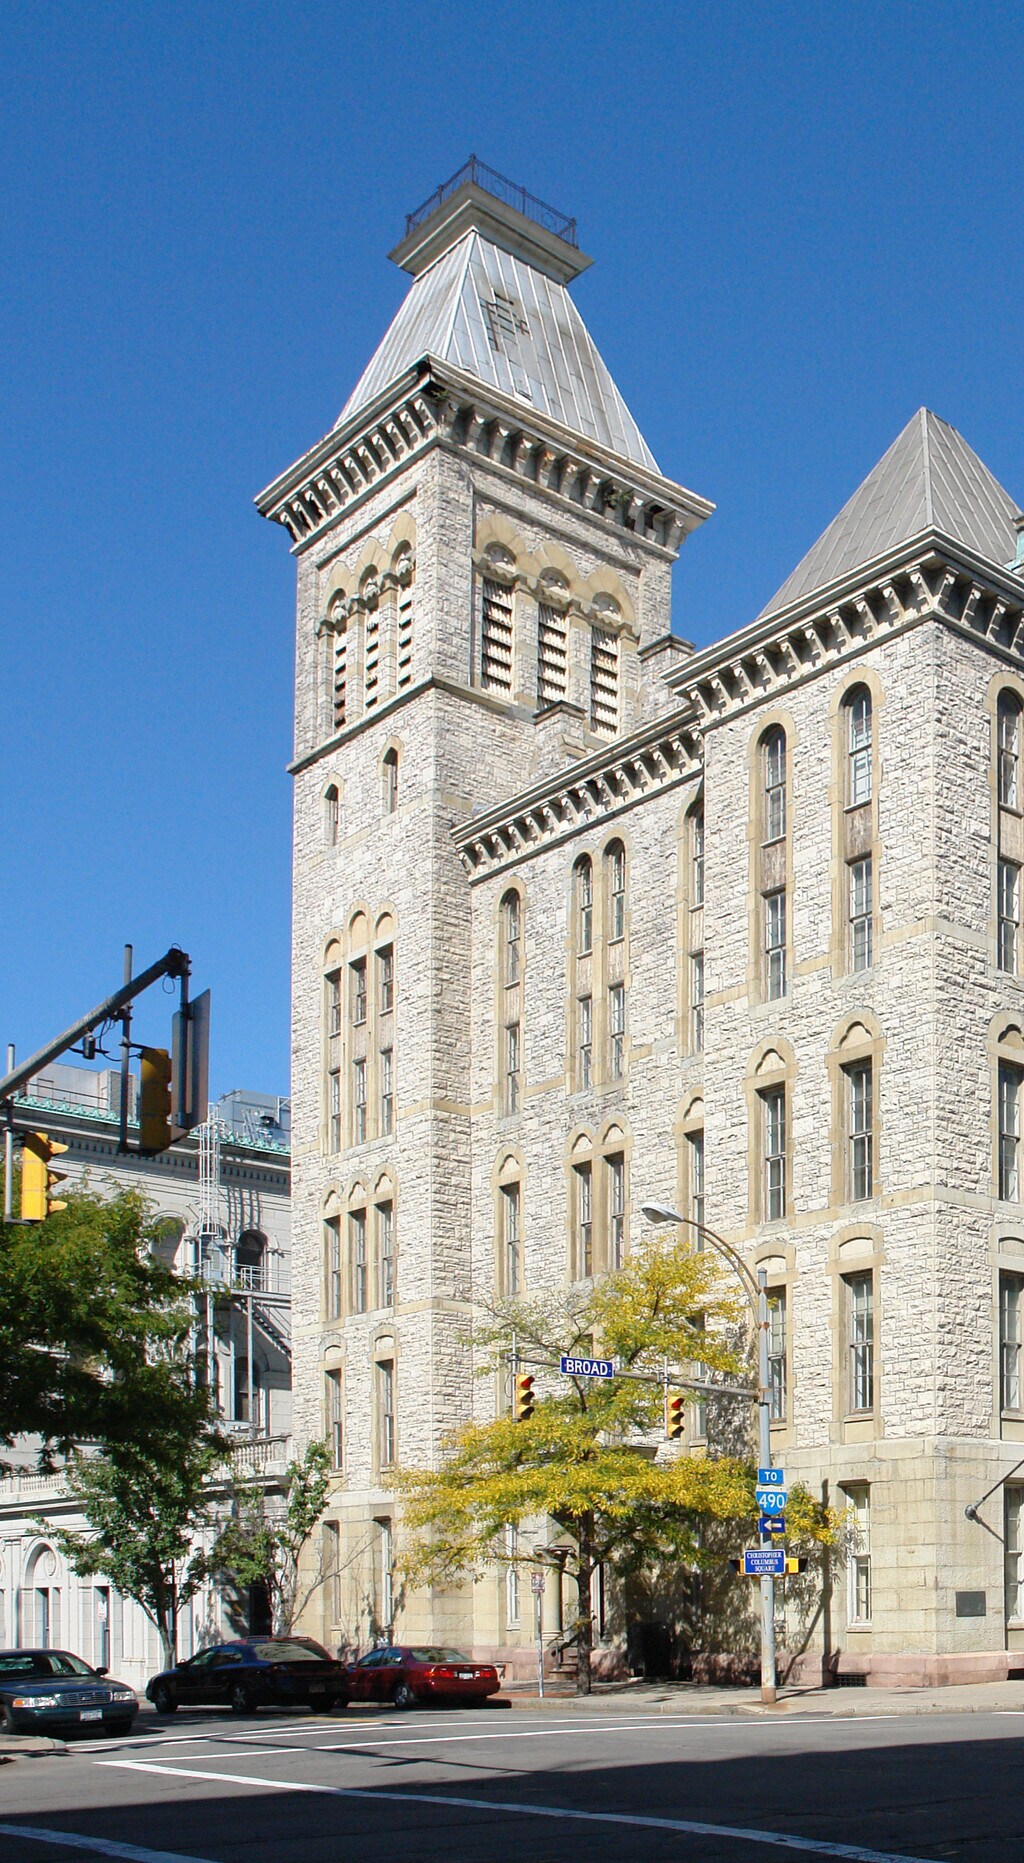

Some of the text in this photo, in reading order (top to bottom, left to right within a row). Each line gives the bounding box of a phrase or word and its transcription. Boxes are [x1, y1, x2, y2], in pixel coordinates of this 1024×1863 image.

[566, 1359, 608, 1375] BROAD
[765, 1471, 777, 1481] TO
[759, 1493, 785, 1509] 490
